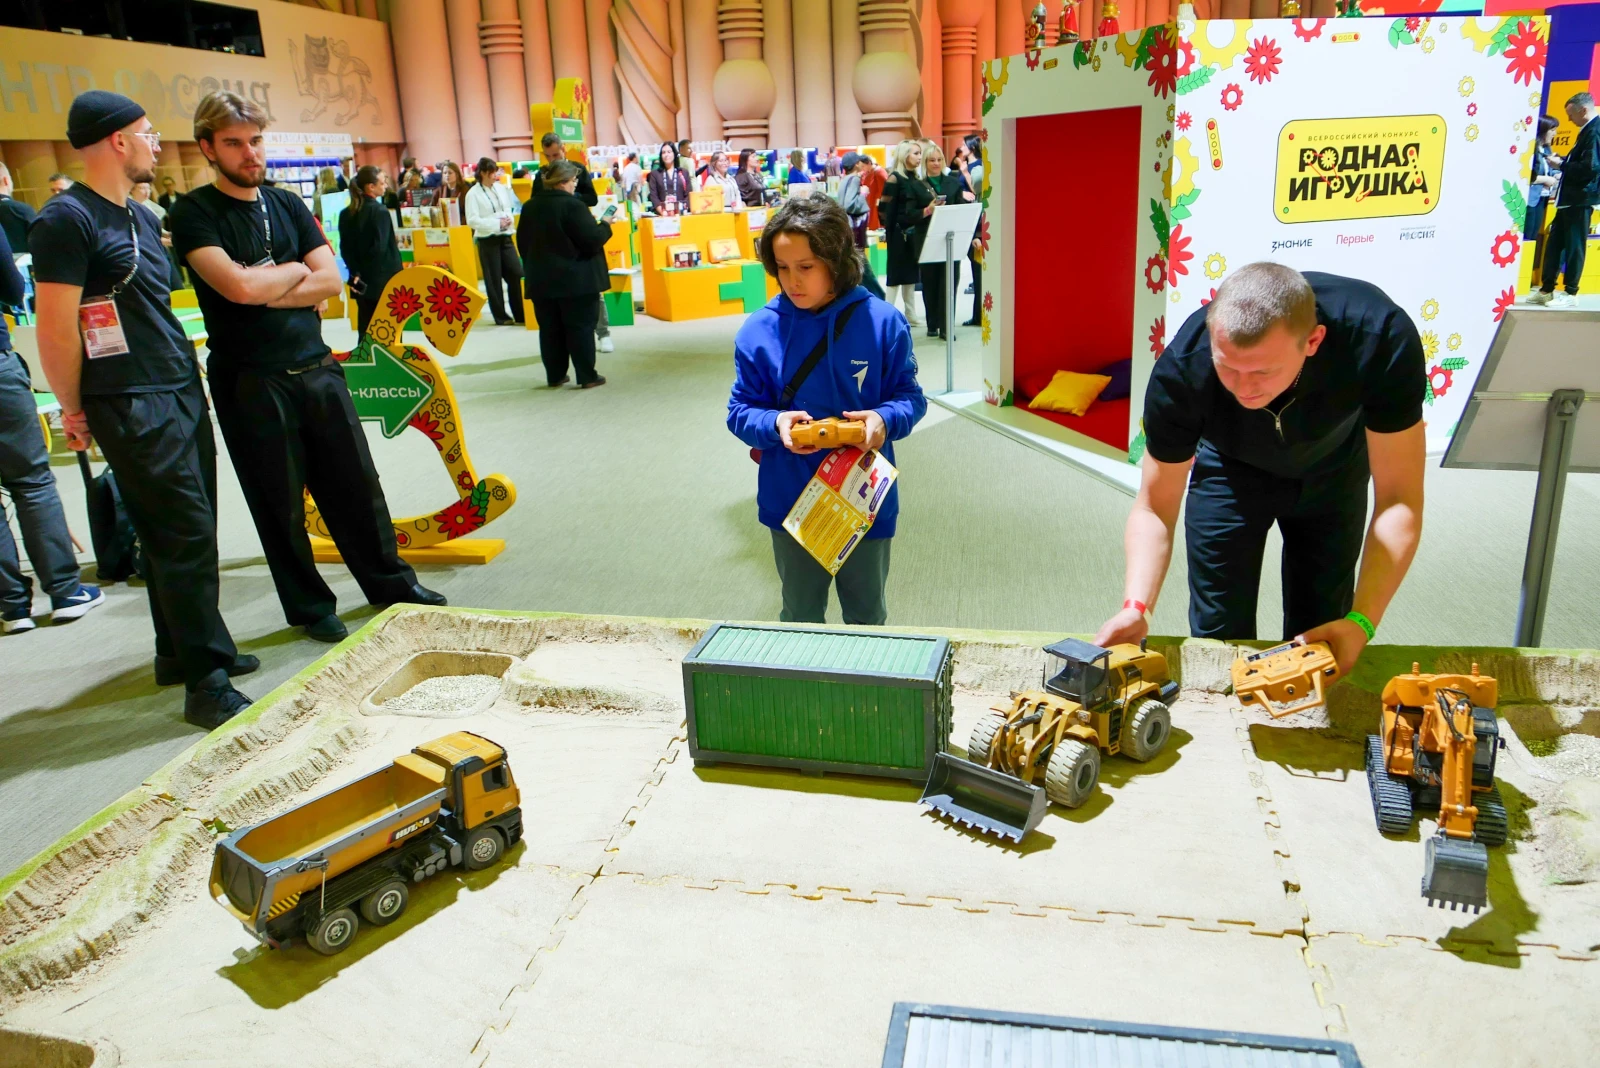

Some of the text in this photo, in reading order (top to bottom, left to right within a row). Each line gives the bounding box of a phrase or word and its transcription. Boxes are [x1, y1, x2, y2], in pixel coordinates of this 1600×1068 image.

[1308, 130, 1419, 141] ВСЕРОССИЙСКИЙ КОНКУРС
[1299, 143, 1420, 172] РОДНАЯ
[1289, 171, 1428, 202] ИГРУШКА
[1336, 234, 1374, 247] Первые
[1399, 230, 1436, 241] РОССИЯ
